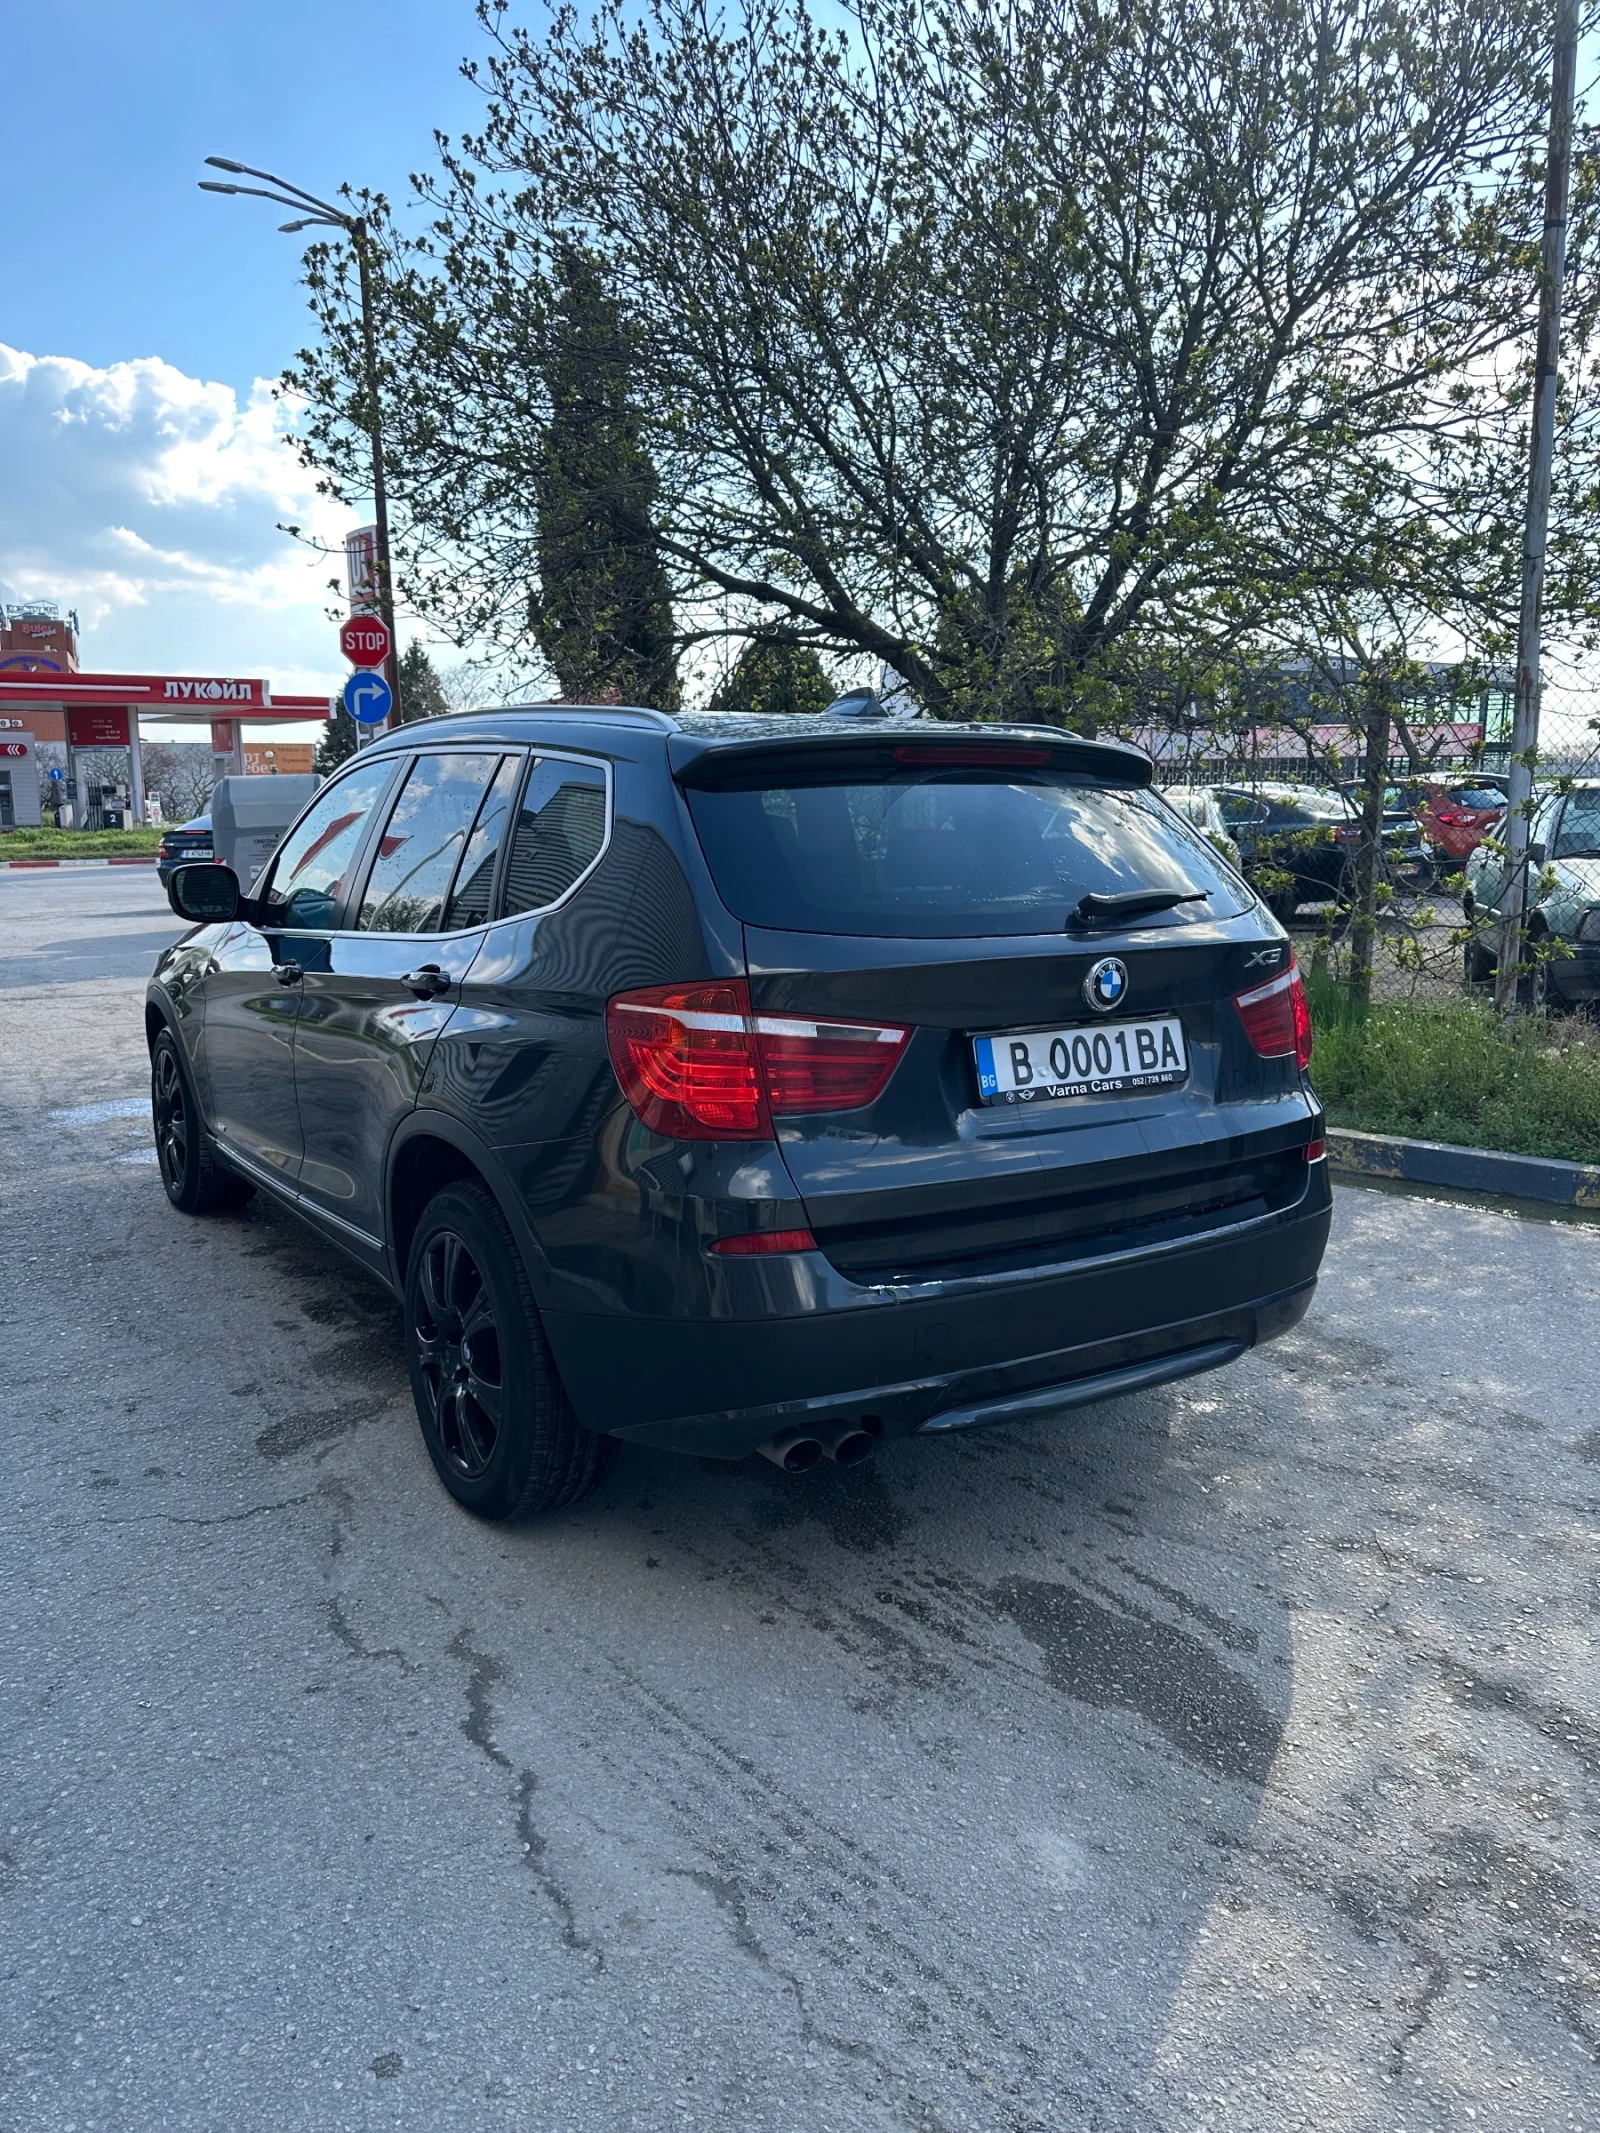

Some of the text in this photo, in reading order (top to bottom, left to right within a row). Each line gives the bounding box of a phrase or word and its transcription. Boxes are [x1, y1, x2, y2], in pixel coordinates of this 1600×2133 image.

[345, 632, 385, 651] STOP
[163, 679, 252, 700] ЛУКОЙЛ
[71, 732, 78, 740] 2
[110, 814, 117, 823] 2
[1244, 948, 1282, 968] X3
[1097, 963, 1126, 978] BMW
[981, 1075, 996, 1089] BG
[1047, 1084, 1088, 1098] Varna
[1091, 1079, 1123, 1092] Cars
